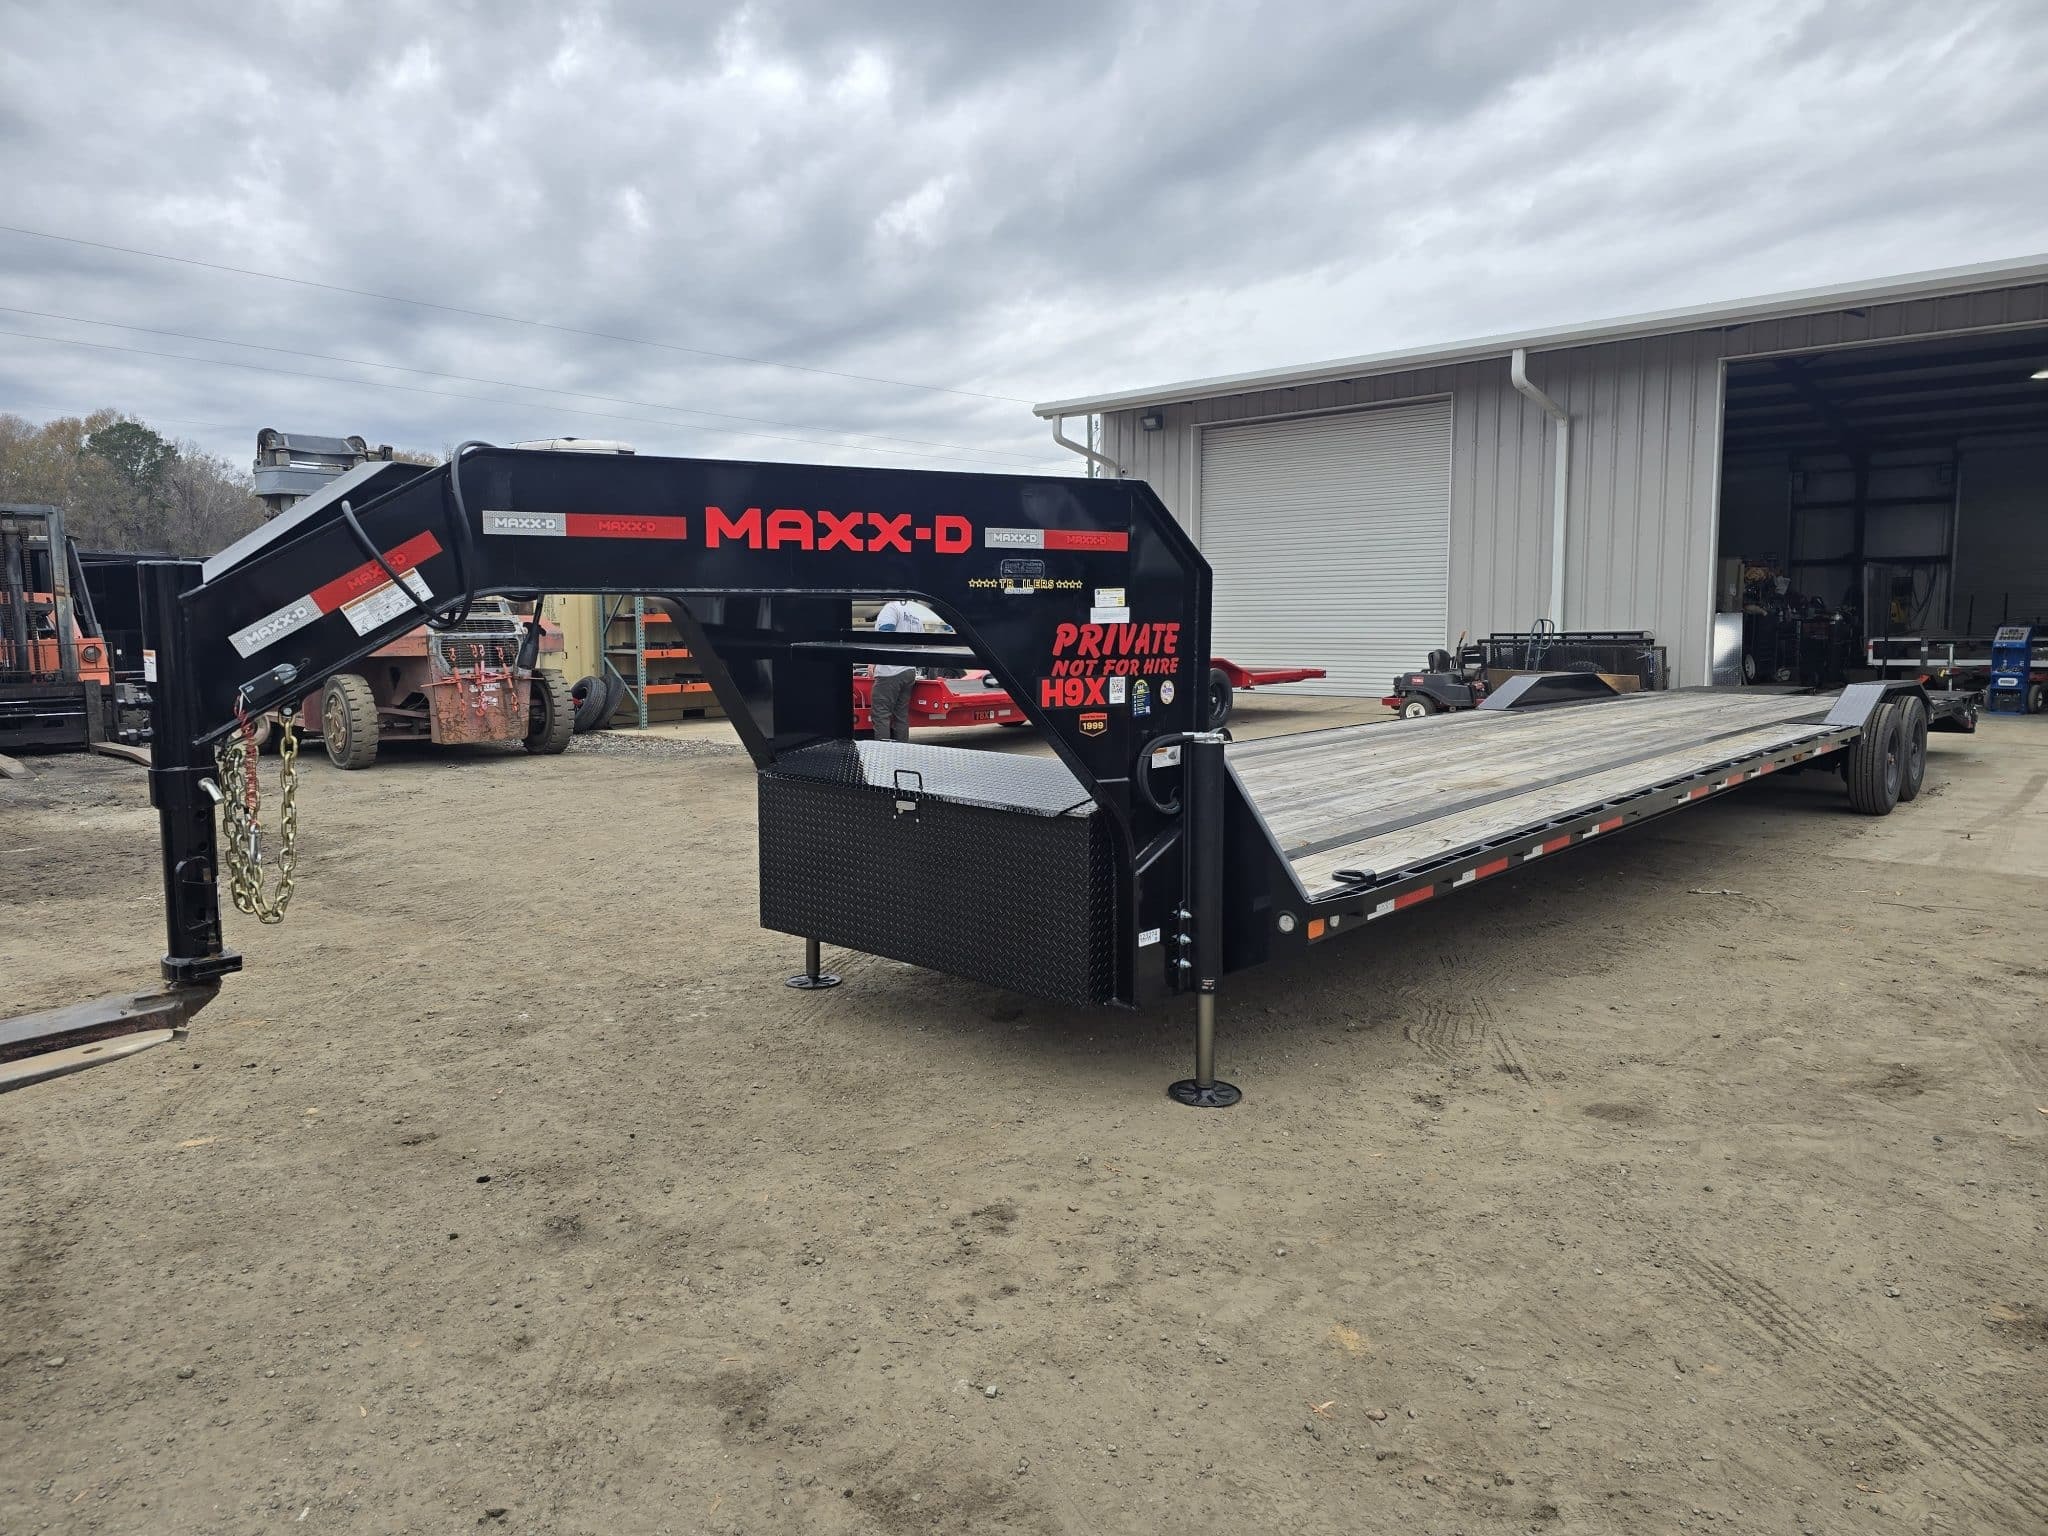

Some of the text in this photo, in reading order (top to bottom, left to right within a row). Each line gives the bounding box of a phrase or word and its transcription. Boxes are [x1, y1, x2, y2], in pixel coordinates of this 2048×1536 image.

[494, 517, 556, 529] MAXX-D
[705, 506, 973, 554] MAXX-D
[992, 532, 1038, 543] MAXX-D
[999, 578, 1054, 589] TRILERS
[244, 606, 308, 646] MAXX-D
[1052, 622, 1180, 659] PRIVATE
[1051, 657, 1180, 677] NOT FOR HIRE
[1041, 677, 1107, 708] H9X
[1082, 721, 1104, 731] 1999
